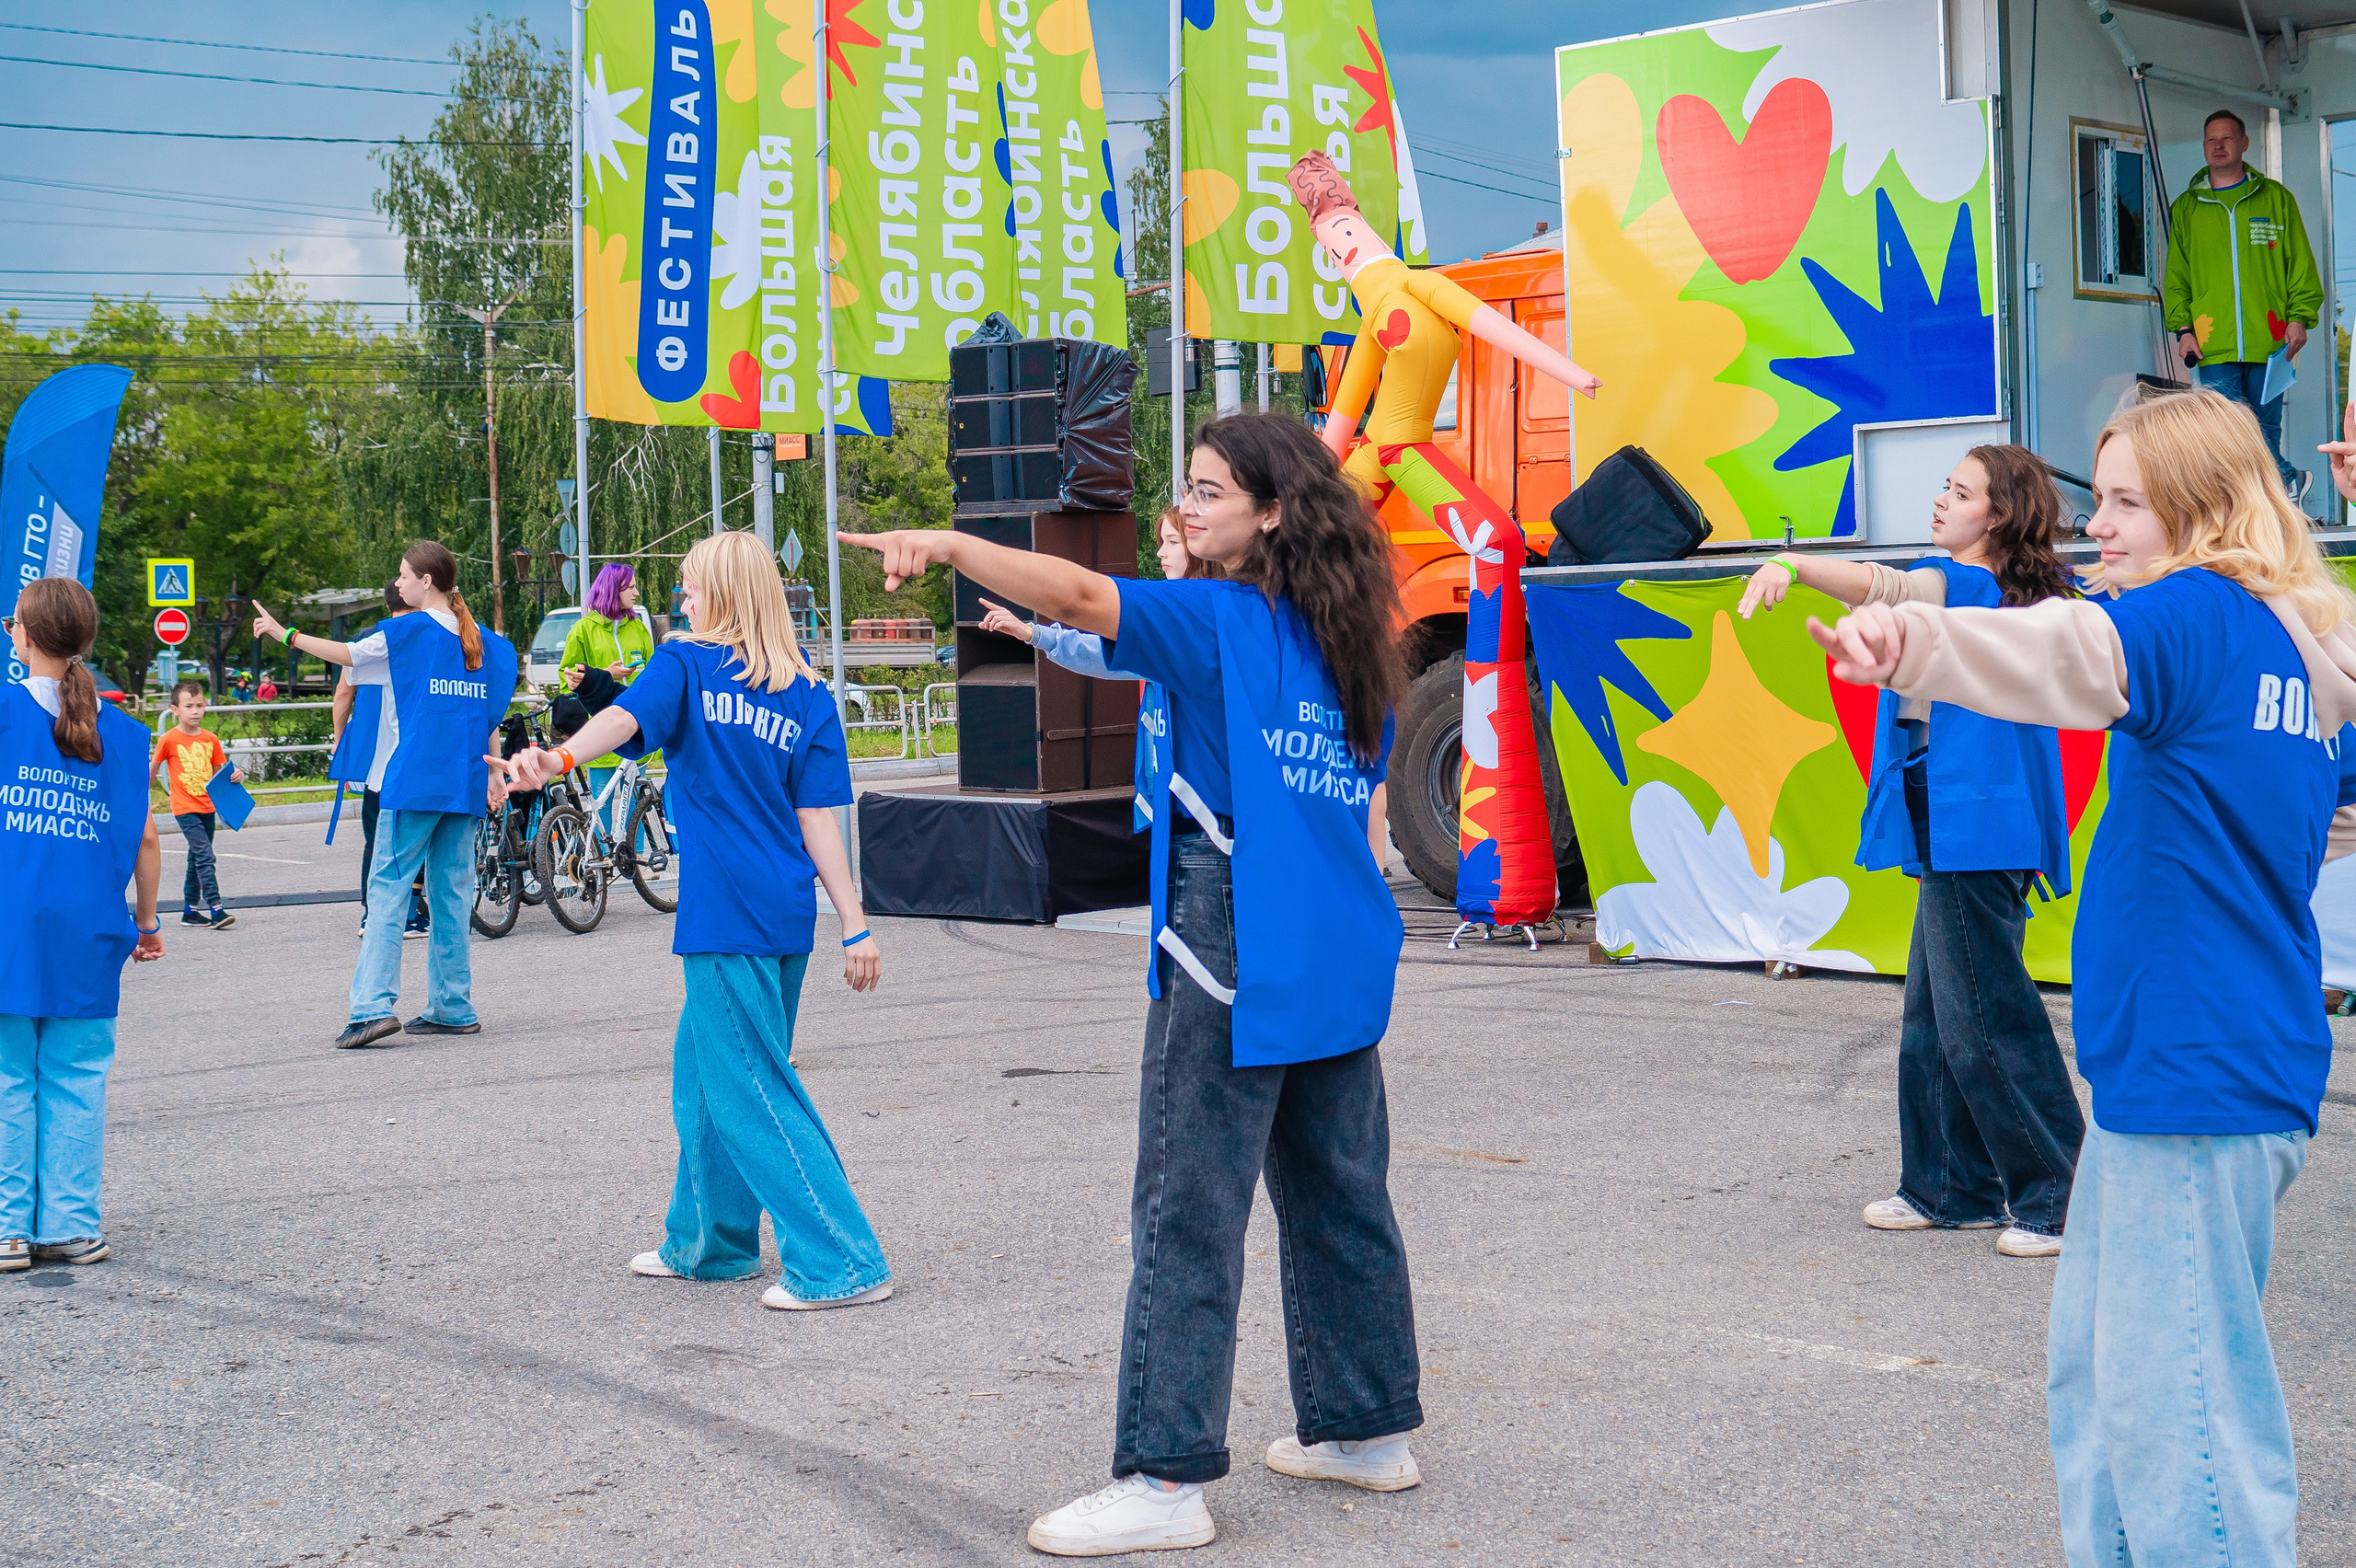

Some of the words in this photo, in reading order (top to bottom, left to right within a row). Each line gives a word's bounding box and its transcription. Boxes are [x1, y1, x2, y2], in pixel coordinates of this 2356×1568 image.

[656, 10, 700, 372] ФЕСТИВАЛЬ
[1312, 84, 1351, 320] сеья
[23, 513, 47, 560] ГТО
[6, 811, 100, 844] МИАССА
